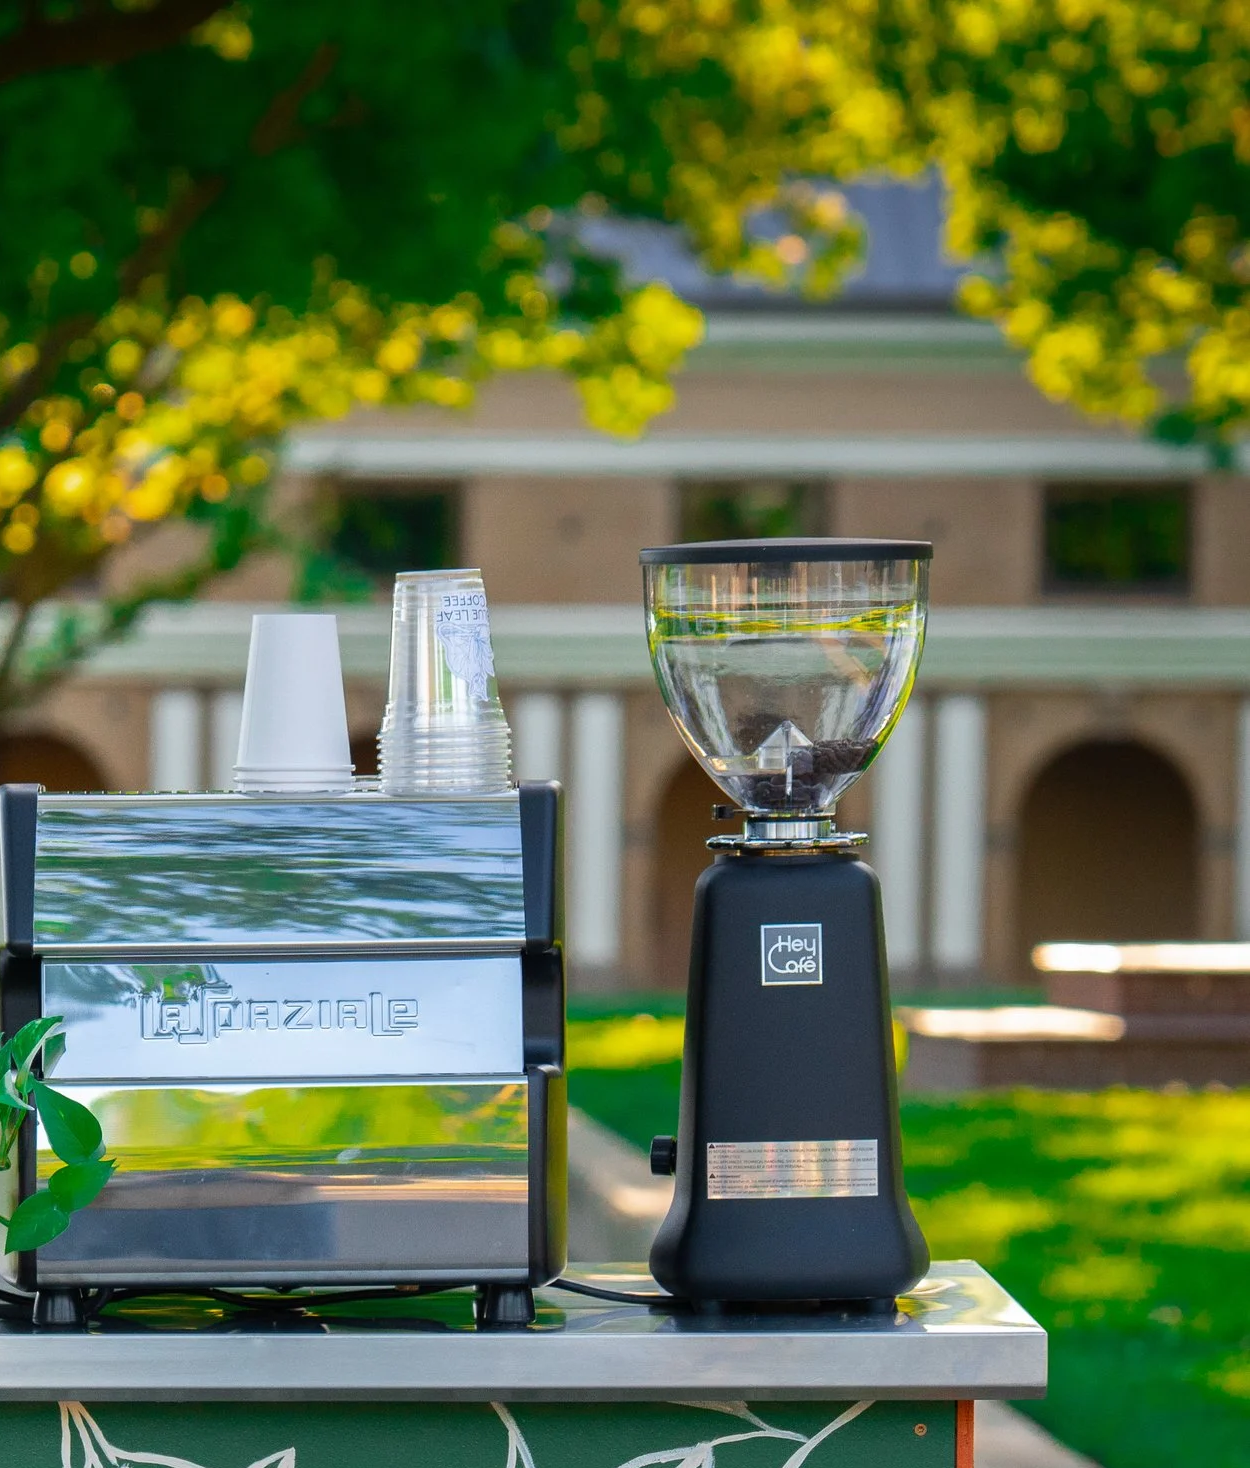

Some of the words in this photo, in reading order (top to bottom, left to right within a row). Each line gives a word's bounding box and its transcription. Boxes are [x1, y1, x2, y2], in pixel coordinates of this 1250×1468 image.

[442, 594, 486, 608] COFFEE
[436, 609, 470, 623] LEAF
[778, 935, 816, 956] Hey
